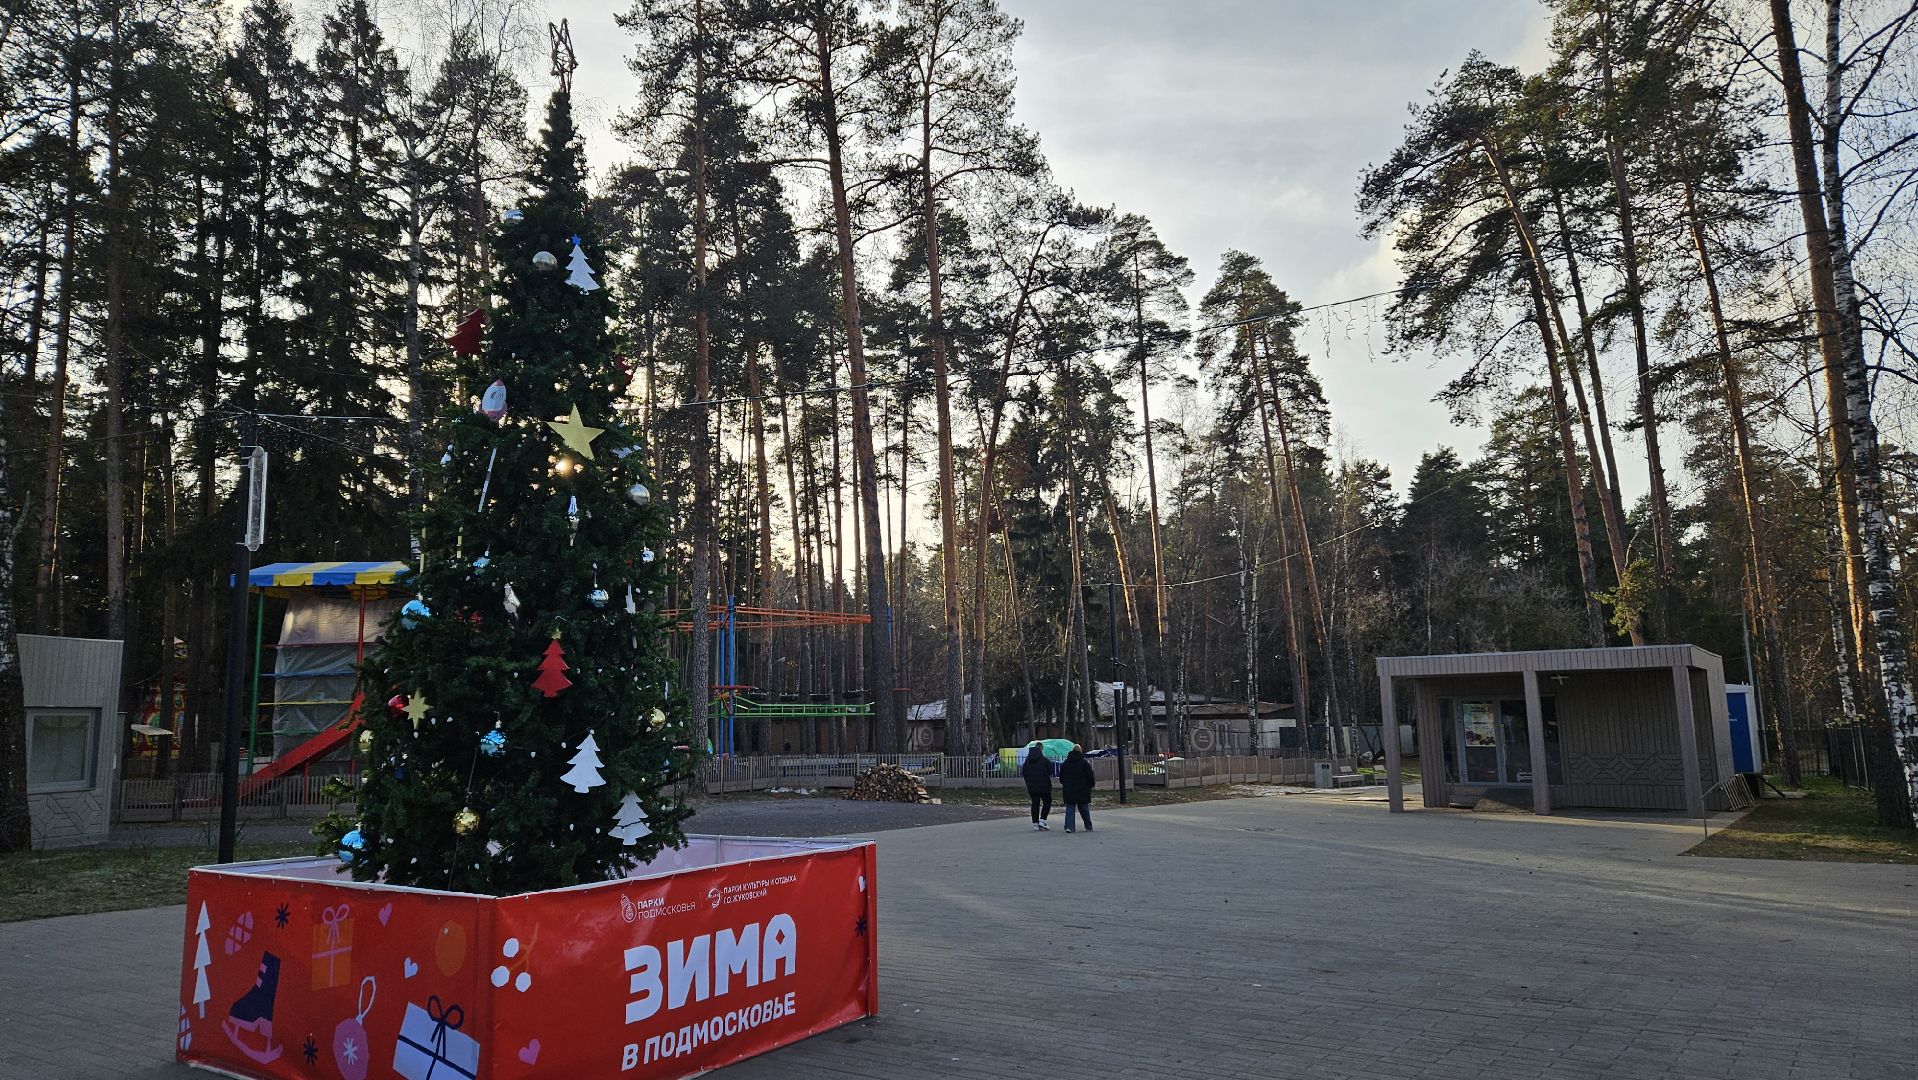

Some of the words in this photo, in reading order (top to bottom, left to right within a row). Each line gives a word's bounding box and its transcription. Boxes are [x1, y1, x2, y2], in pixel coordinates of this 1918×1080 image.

[724, 885, 742, 894] ПАРКИ
[743, 879, 770, 890] КУЛЬТУРЫ
[775, 875, 797, 885] ОТДЫХА
[637, 897, 665, 910] ПАРКИ
[638, 902, 696, 920] ПОДМОСКОВЬЯ
[624, 913, 797, 1024] ЗИМА
[621, 1043, 638, 1072] В
[643, 991, 796, 1065] ПОДМОСКОВЬЕ
